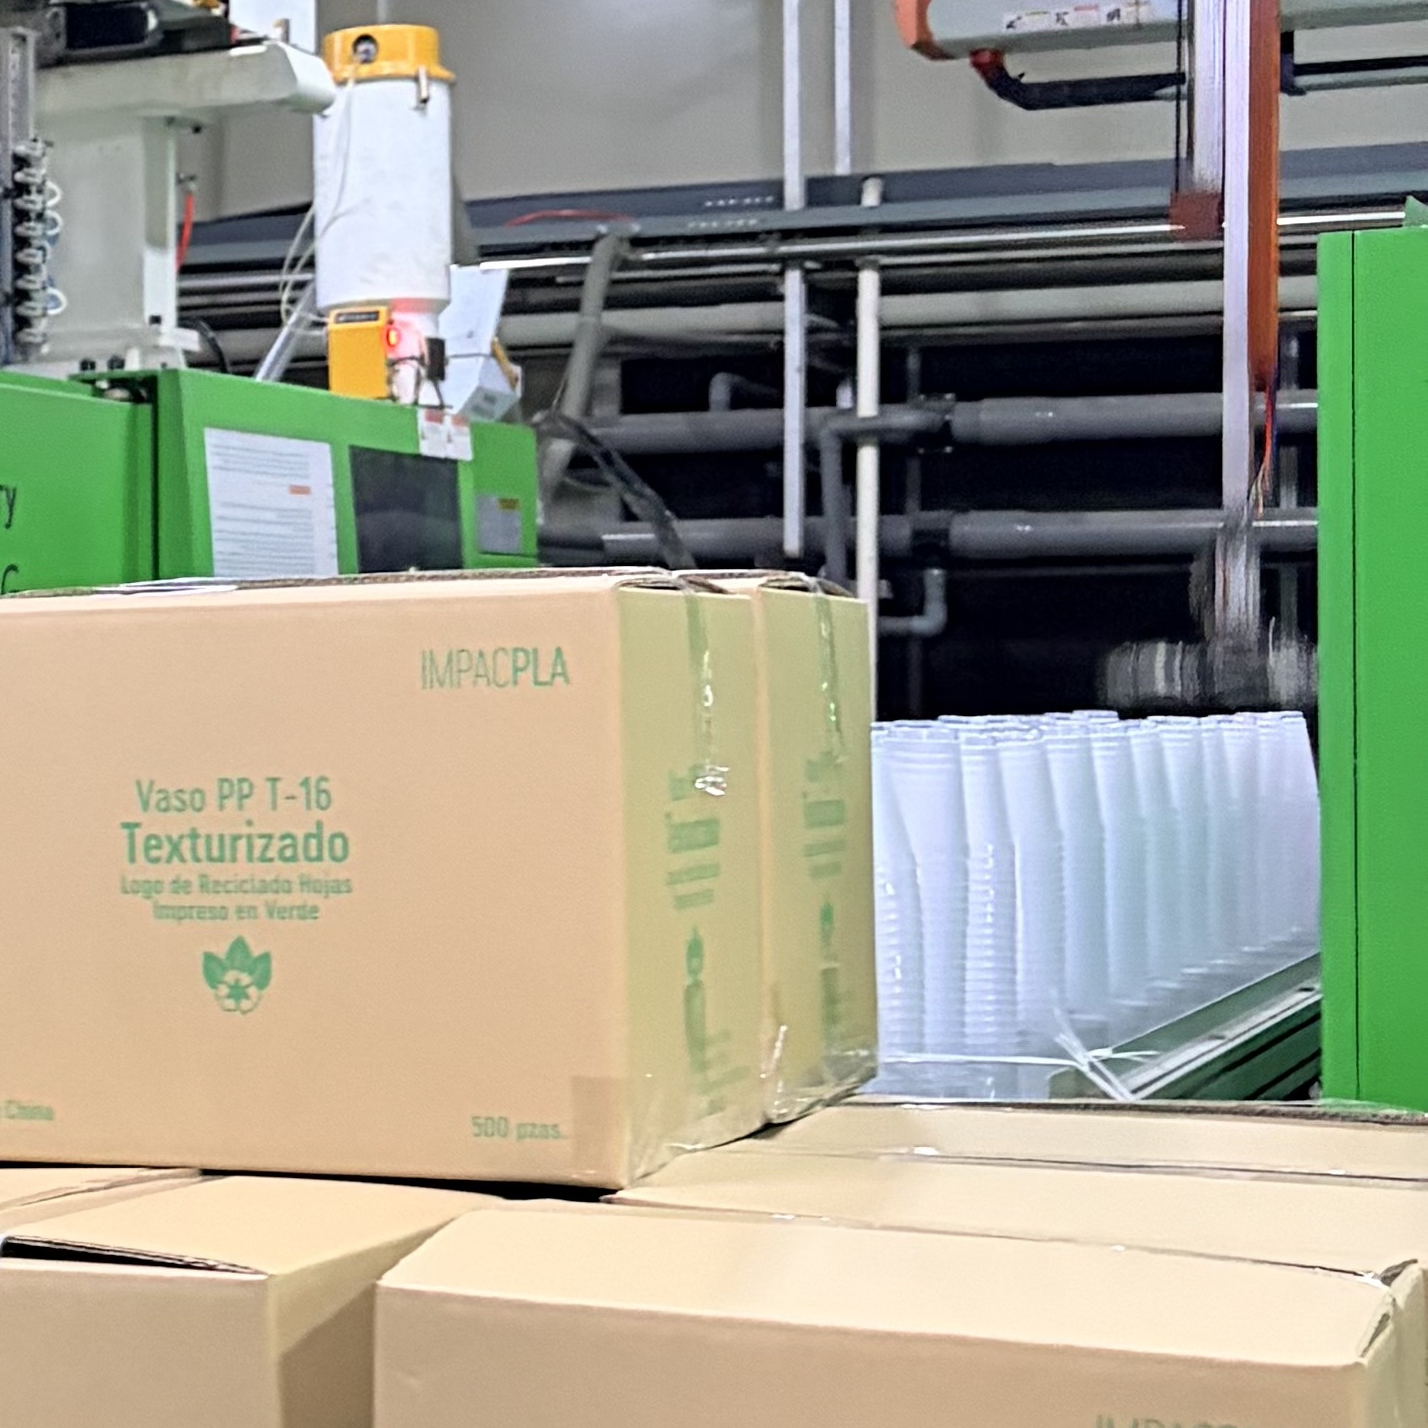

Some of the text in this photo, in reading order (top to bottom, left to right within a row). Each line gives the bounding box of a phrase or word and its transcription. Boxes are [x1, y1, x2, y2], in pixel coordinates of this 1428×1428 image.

[420, 646, 571, 689] IMPACPLA
[135, 775, 332, 814] Vaso PP T-16
[120, 819, 350, 865] Texturizado
[120, 874, 352, 899] Logo de Reciclado Hojas
[152, 900, 319, 923] Impreso en Verde
[471, 1115, 509, 1139] 500
